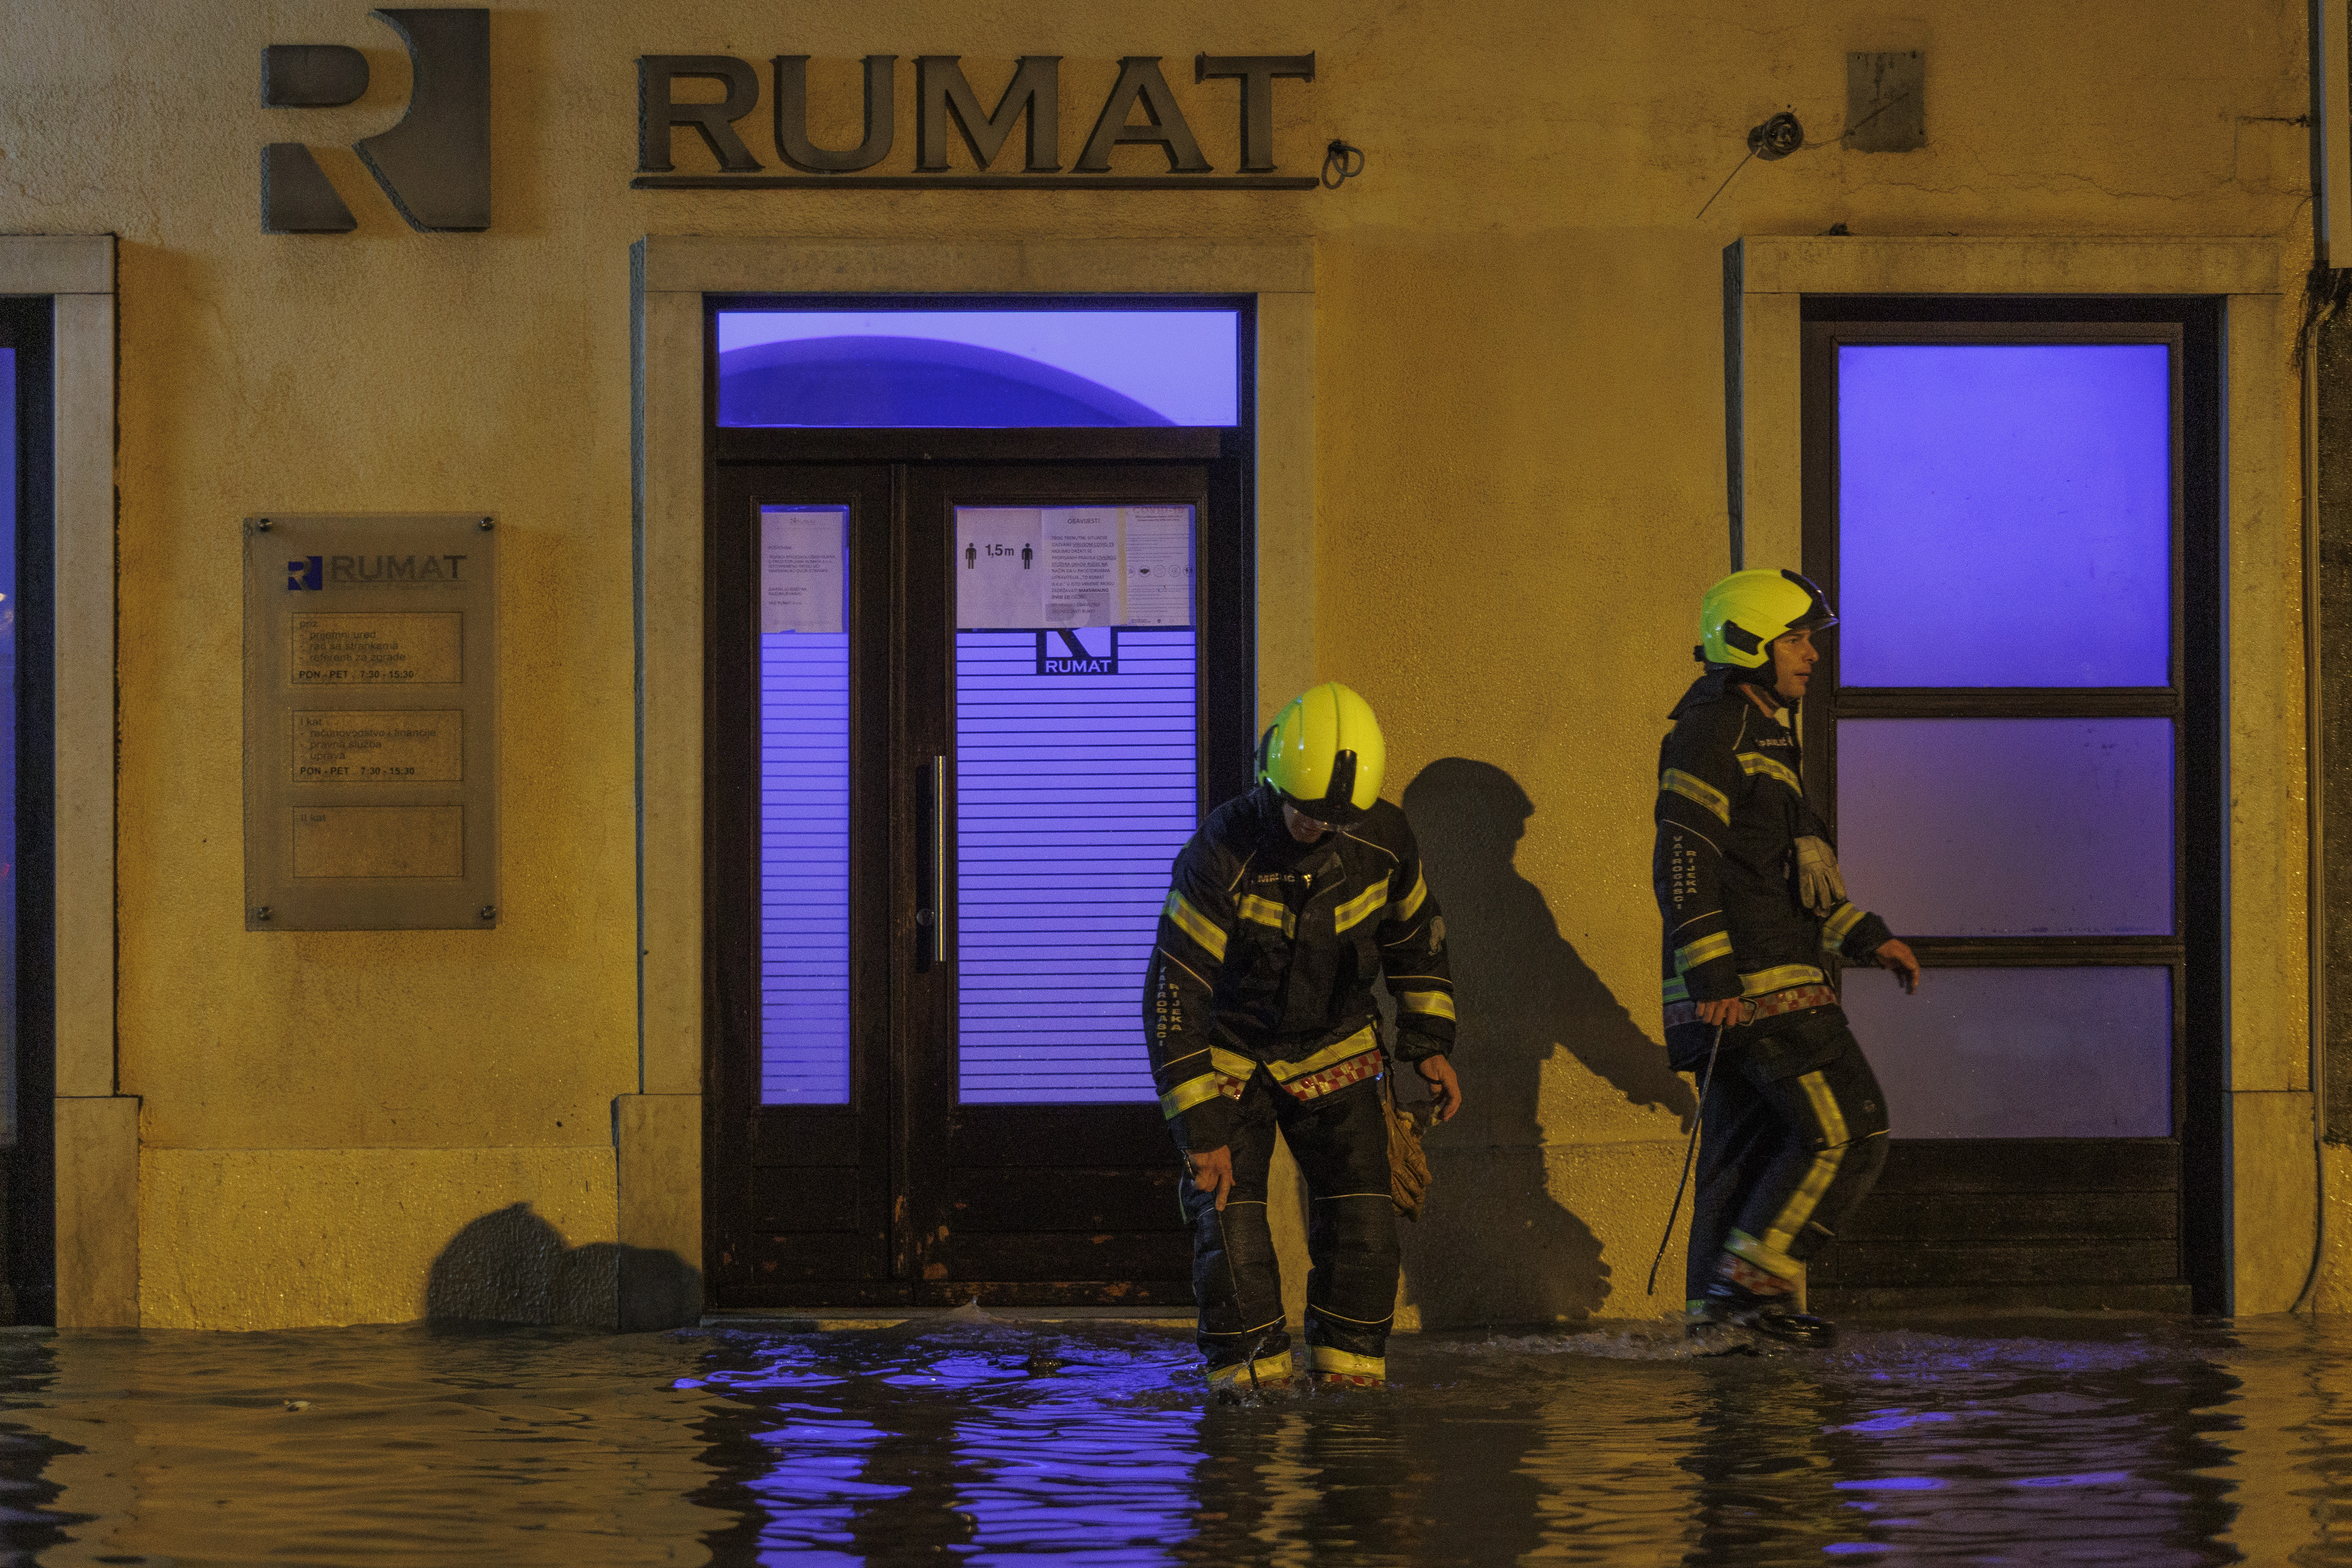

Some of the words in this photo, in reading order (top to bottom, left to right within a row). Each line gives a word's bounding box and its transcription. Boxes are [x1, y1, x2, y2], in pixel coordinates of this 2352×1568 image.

[635, 52, 1315, 174] RUMAT
[331, 555, 467, 580] RUMAT
[353, 631, 376, 639] ured
[370, 653, 406, 663] zgrade
[1045, 660, 1112, 673] RUMAT
[299, 670, 321, 678] PON
[329, 670, 348, 678] PET
[389, 670, 415, 678] 15:30
[394, 728, 436, 740] financije
[349, 740, 382, 748] služba
[1672, 835, 1684, 910] VATROGASCI
[1686, 850, 1698, 894] RIJEKA
[1156, 967, 1168, 1047] VATROGASCI
[1169, 983, 1182, 1031] RIJEKA
